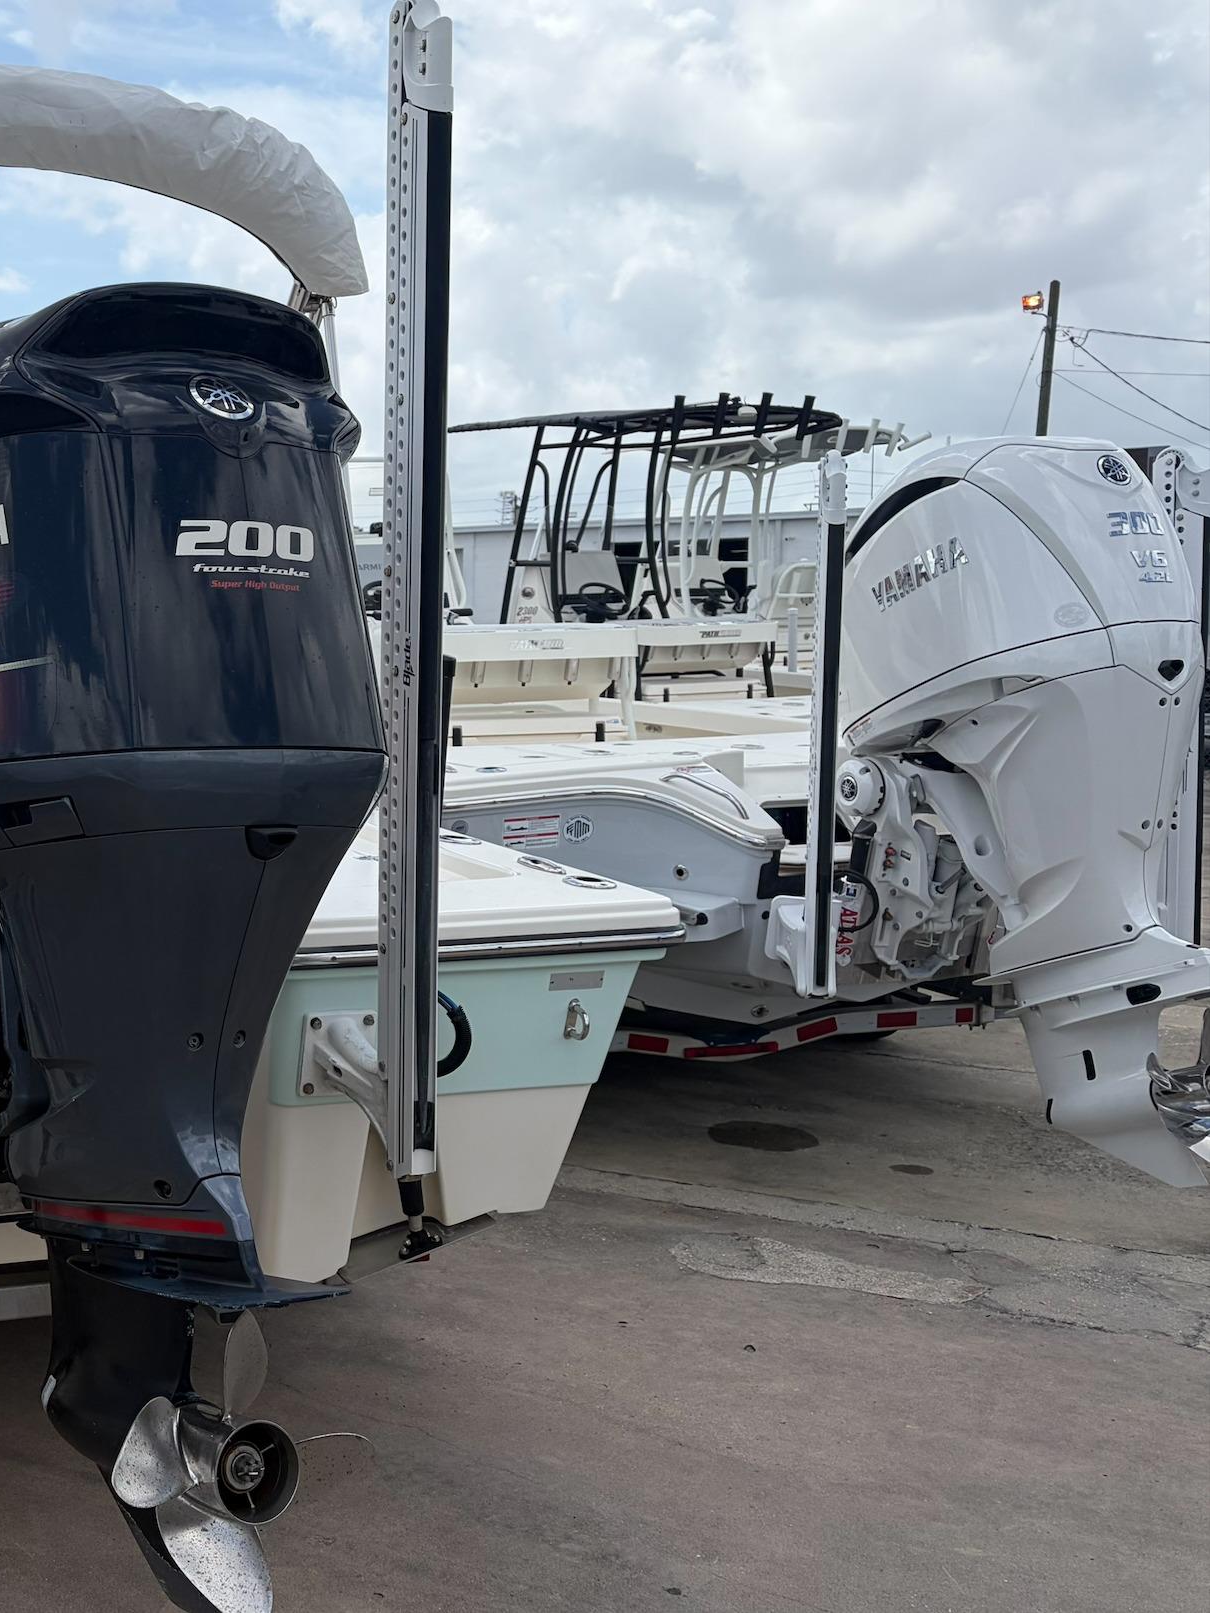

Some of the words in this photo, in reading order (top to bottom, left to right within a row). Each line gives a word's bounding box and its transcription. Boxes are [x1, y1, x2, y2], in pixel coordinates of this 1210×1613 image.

[1106, 511, 1165, 537] 300
[175, 519, 315, 563] 200
[1130, 549, 1168, 568] V6
[210, 579, 242, 589] Super
[244, 579, 267, 591] High
[269, 581, 301, 592] Output
[871, 536, 971, 613] YAMAHA
